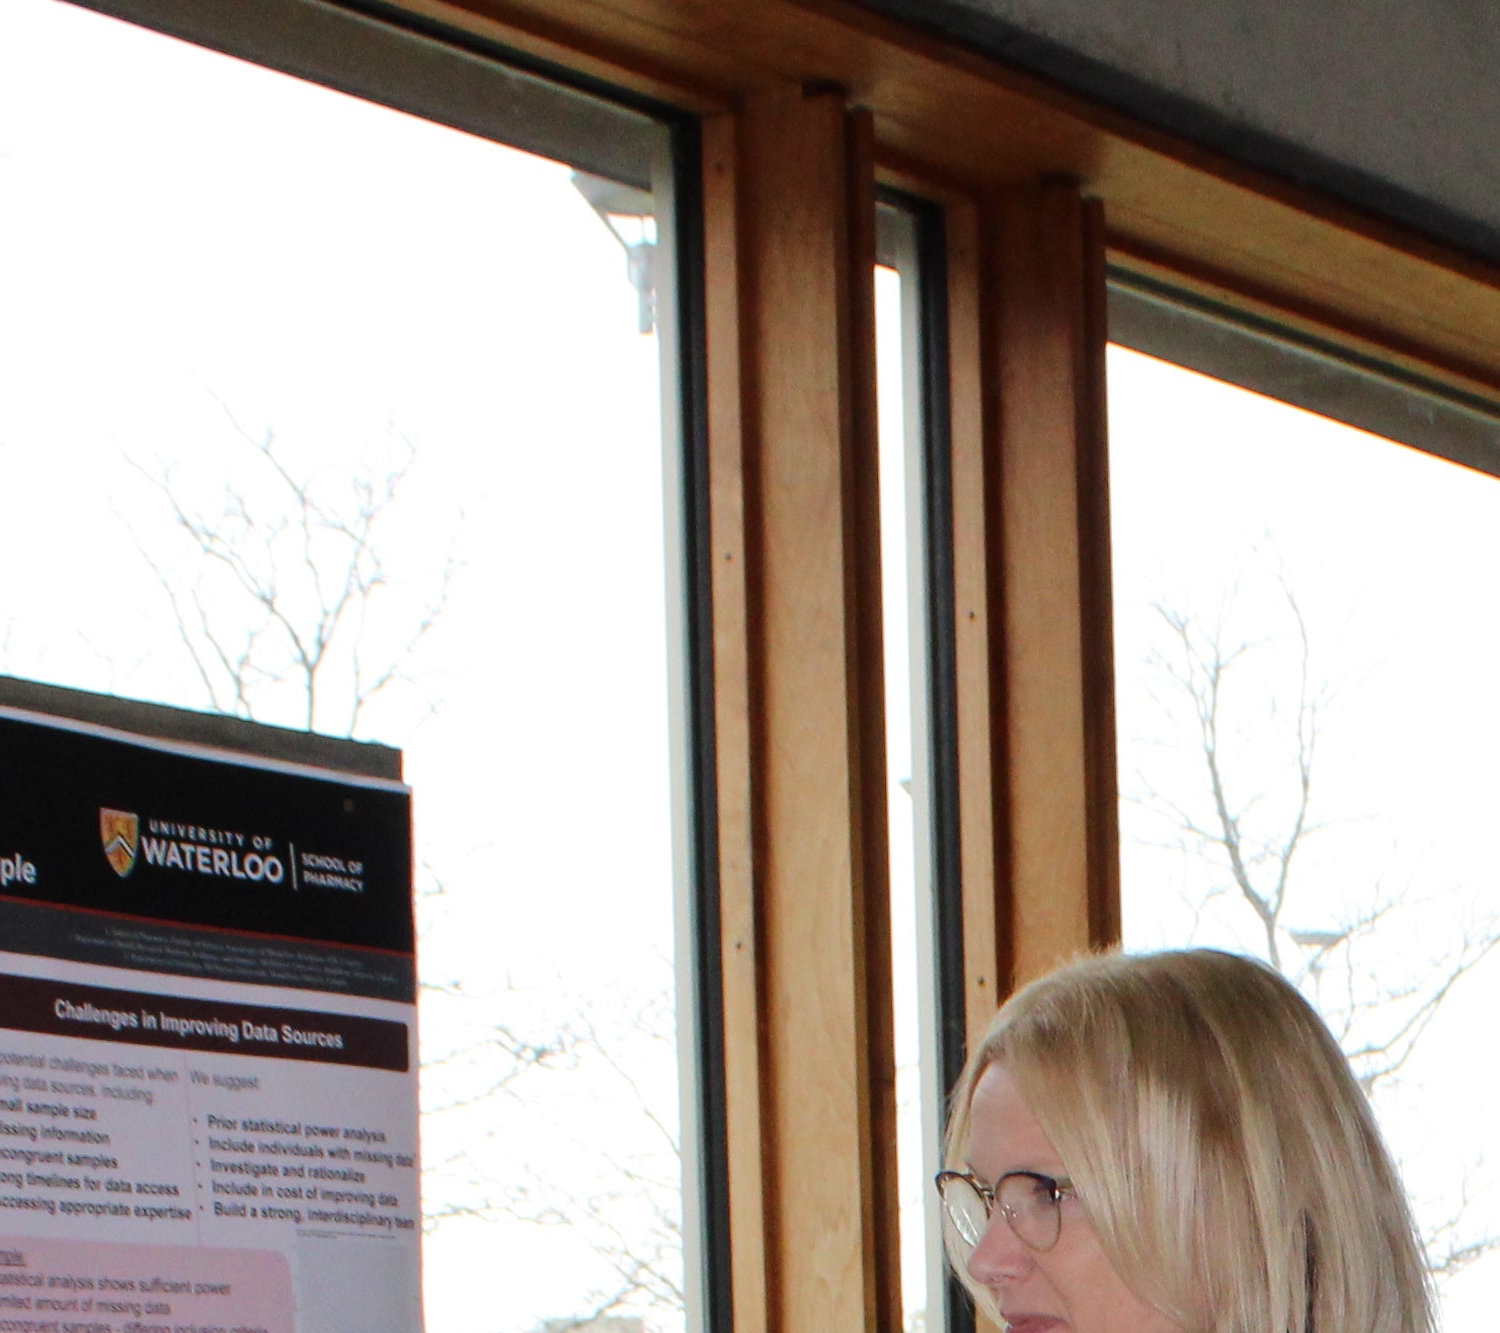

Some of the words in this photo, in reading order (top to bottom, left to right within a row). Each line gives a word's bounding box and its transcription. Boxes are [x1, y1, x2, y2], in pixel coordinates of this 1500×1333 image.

[149, 819, 244, 847] UNIVERSITY
[252, 835, 271, 851] OF
[141, 835, 284, 884] WATERLOO
[301, 852, 346, 873] SCHOOL
[347, 860, 363, 875] OF
[303, 870, 363, 892] PHARMACY
[53, 997, 138, 1032] Challenges
[141, 1009, 157, 1029] in
[159, 1011, 239, 1043] Improving
[241, 1019, 279, 1043] Data
[280, 1023, 343, 1049] Sources
